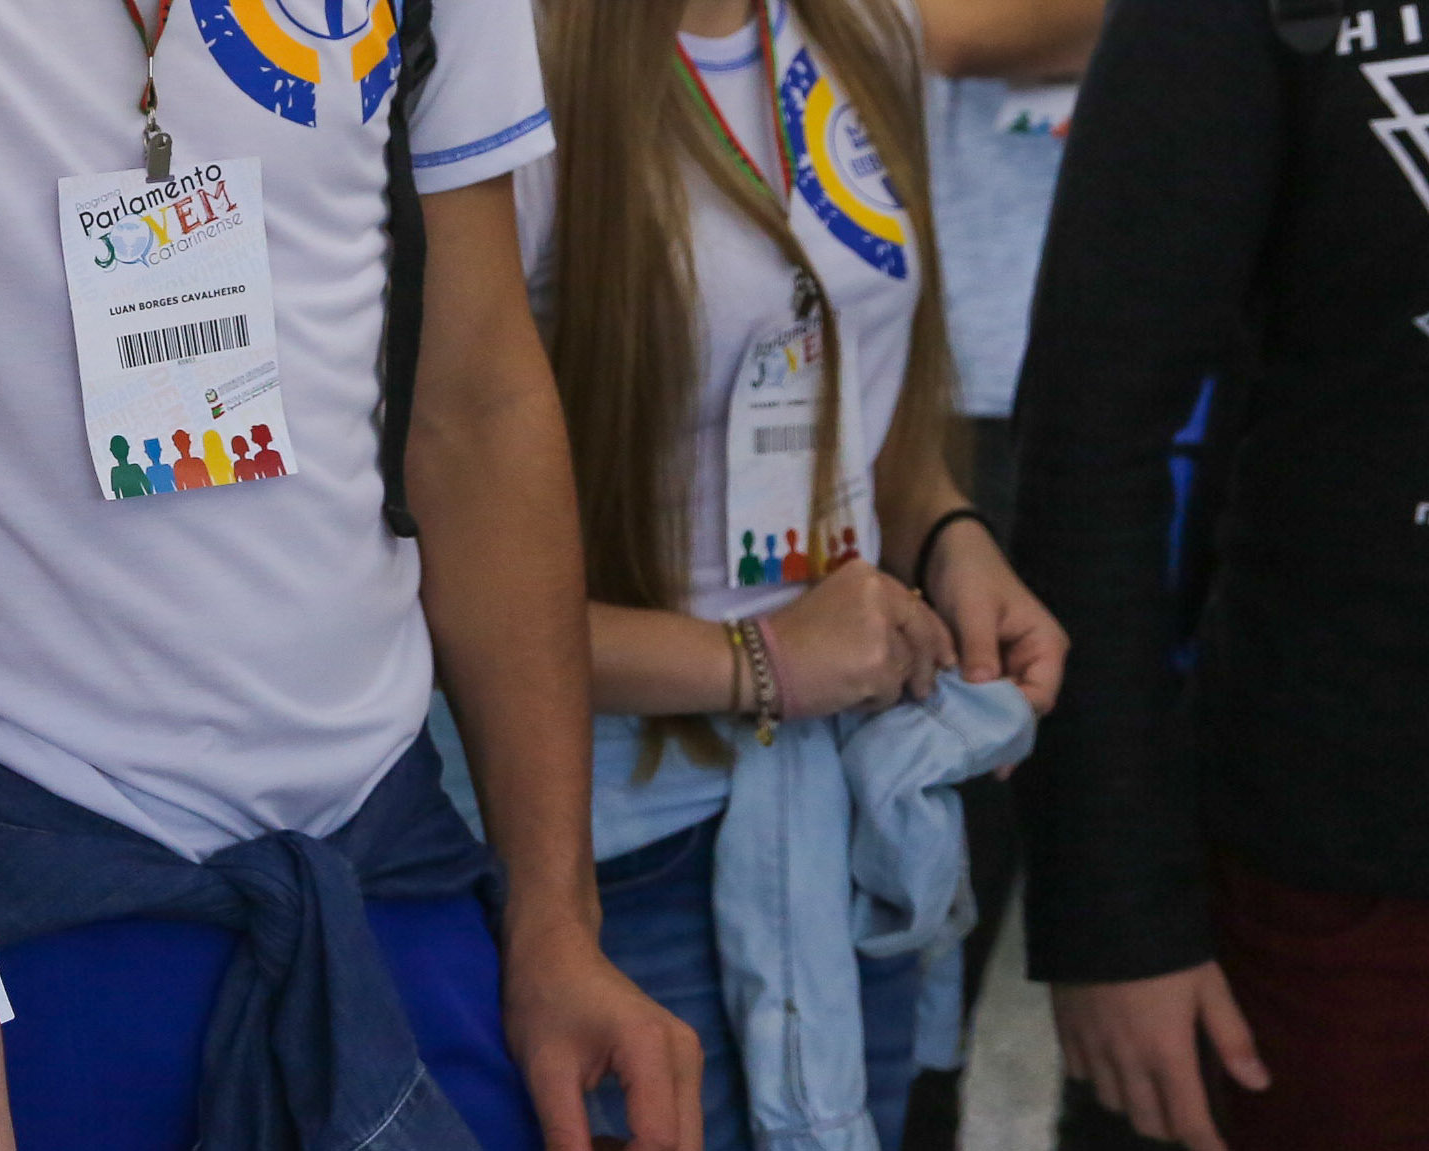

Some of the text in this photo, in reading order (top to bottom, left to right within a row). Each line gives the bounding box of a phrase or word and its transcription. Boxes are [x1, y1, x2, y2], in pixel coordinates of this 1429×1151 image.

[79, 164, 221, 236] Parlamento
[94, 180, 238, 269] JOVEM
[149, 213, 243, 265] catarinense
[109, 284, 246, 316] LUAN BORGES CAVALHEIRO
